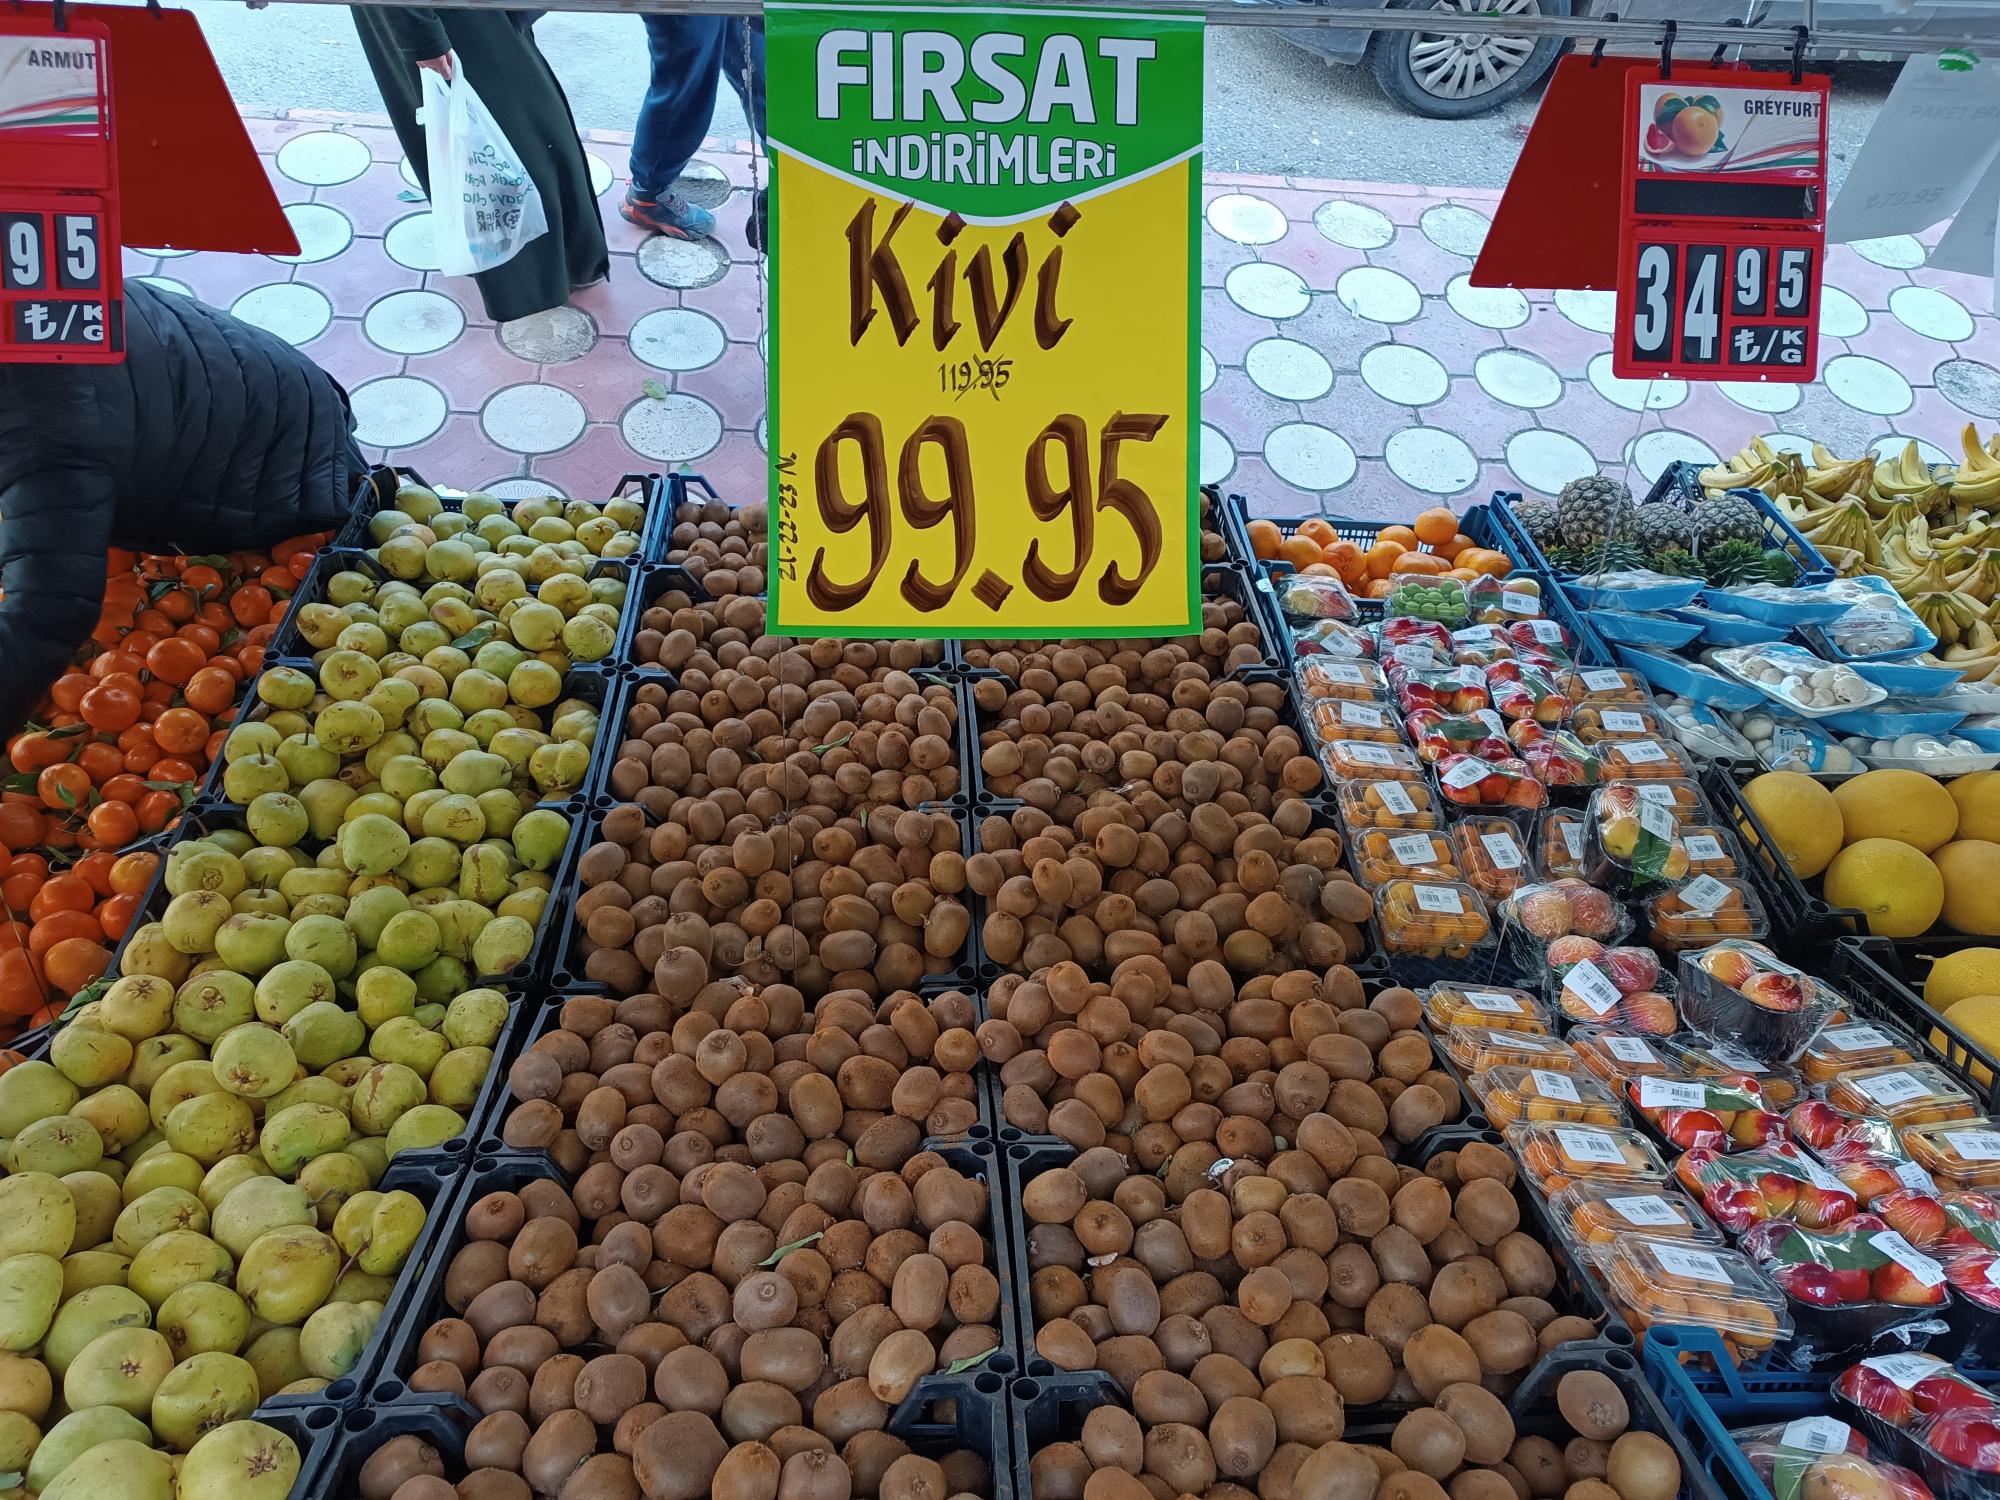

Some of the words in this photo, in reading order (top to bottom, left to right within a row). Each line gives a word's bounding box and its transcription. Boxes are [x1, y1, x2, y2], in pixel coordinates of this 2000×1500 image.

[28, 49, 96, 70] ARMUT
[815, 28, 1157, 126] FIRSAT
[1744, 99, 1821, 118] GREYFURT
[845, 197, 1081, 353] Kivi
[796, 411, 1169, 612] 99.95
